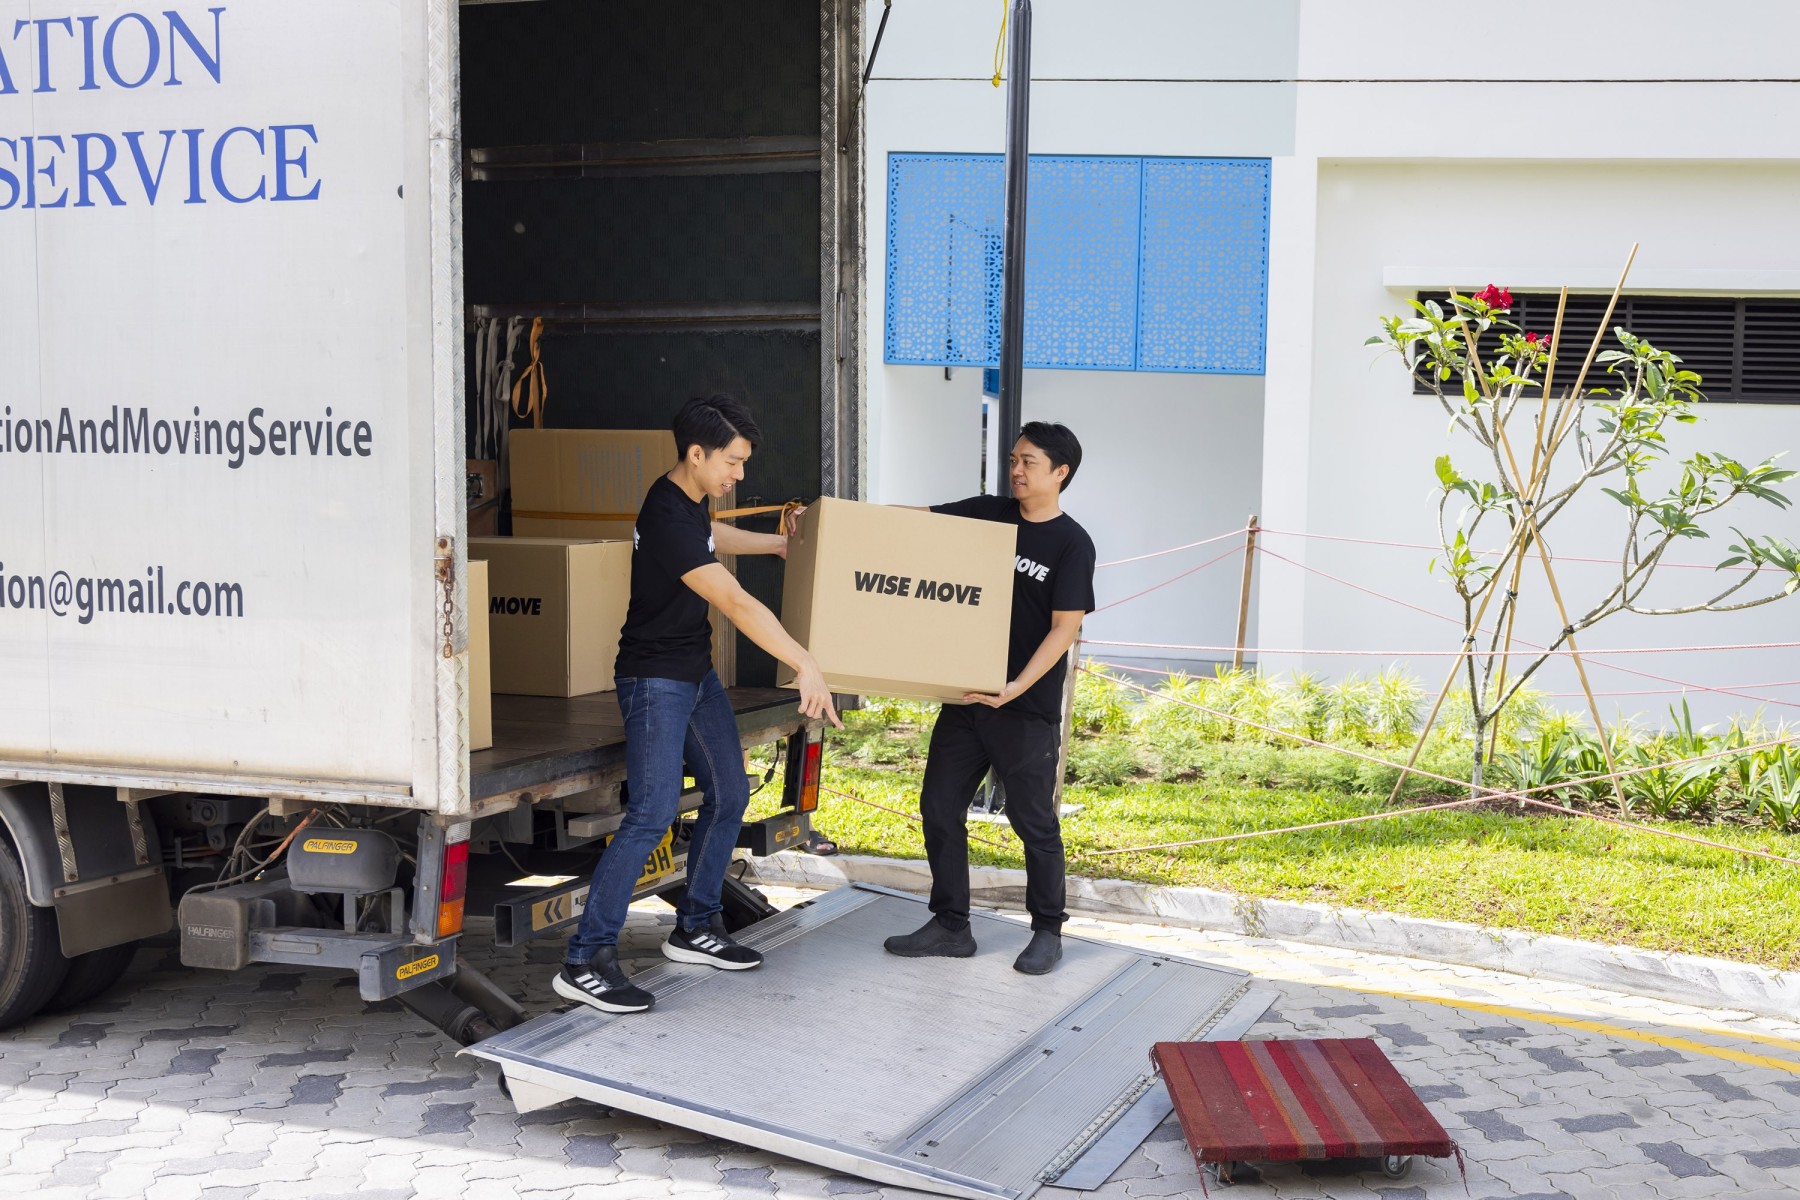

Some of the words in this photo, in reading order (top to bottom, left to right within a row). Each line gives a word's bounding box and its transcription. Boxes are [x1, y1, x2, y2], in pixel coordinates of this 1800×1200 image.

[0, 404, 373, 469] ionAndMovingService
[854, 570, 911, 597] WISE
[915, 578, 983, 607] MOVE
[489, 596, 542, 616] MOVE
[306, 840, 354, 851] PALFINGER
[399, 956, 436, 977] PALFINGER
